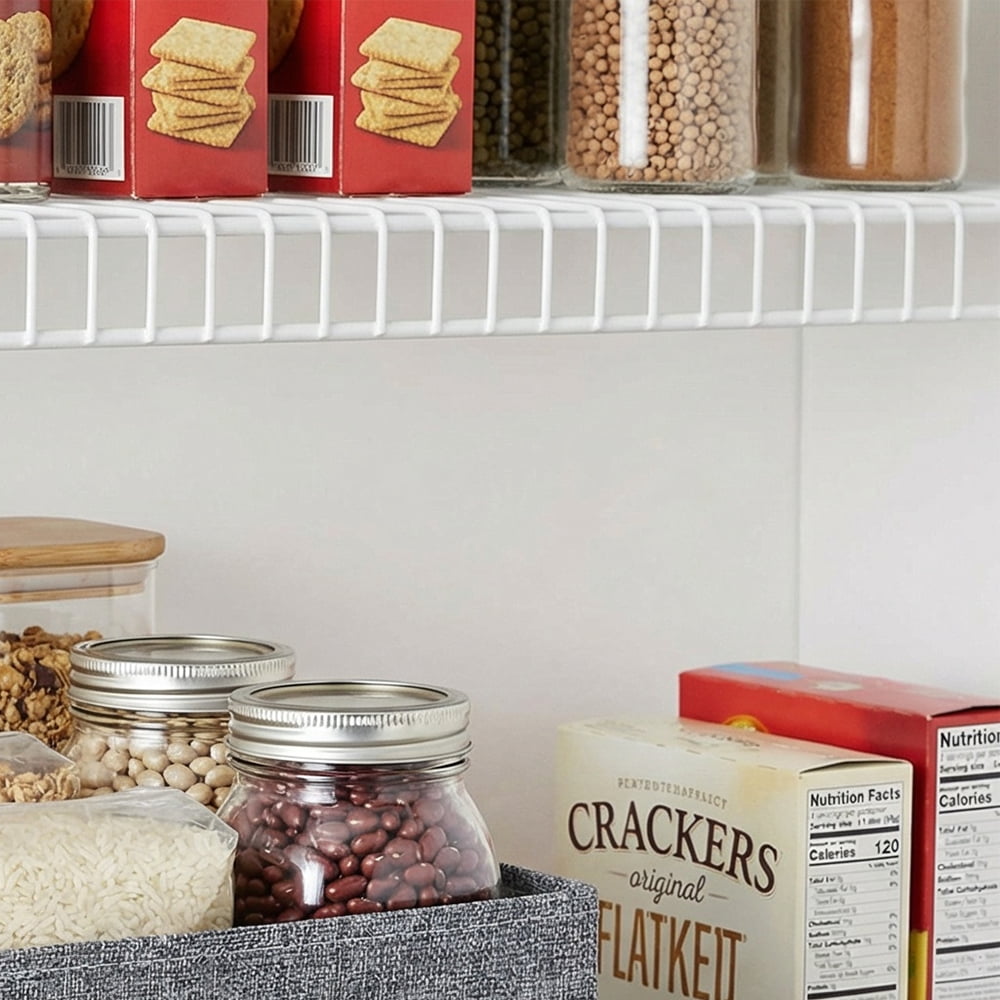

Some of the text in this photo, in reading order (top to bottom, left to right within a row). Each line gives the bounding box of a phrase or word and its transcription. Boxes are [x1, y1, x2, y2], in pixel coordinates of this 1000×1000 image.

[939, 792, 992, 808] Calories
[568, 801, 778, 894] CRACKERS
[875, 838, 899, 854] 120
[629, 868, 706, 904] original
